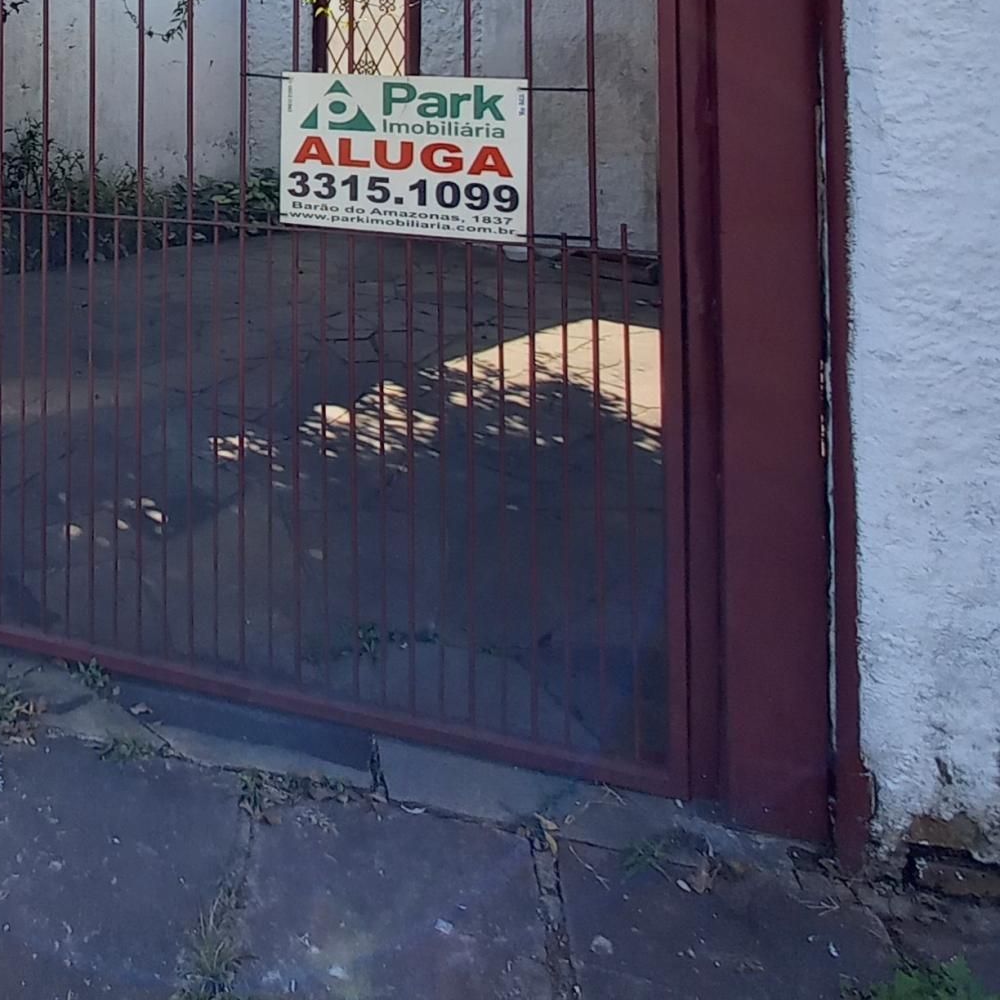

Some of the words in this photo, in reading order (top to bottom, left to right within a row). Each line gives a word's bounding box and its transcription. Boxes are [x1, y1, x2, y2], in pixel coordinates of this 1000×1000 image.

[382, 81, 506, 121] Park
[382, 119, 505, 139] Imobiliária
[292, 136, 514, 178] ALUGA
[287, 171, 520, 213] 3315.1099
[289, 211, 517, 236] www.parkimobiliaria.com.br
[292, 201, 339, 213] Barão
[345, 205, 367, 215] do
[370, 208, 465, 223] Amazonas,
[472, 215, 514, 226] 1837
